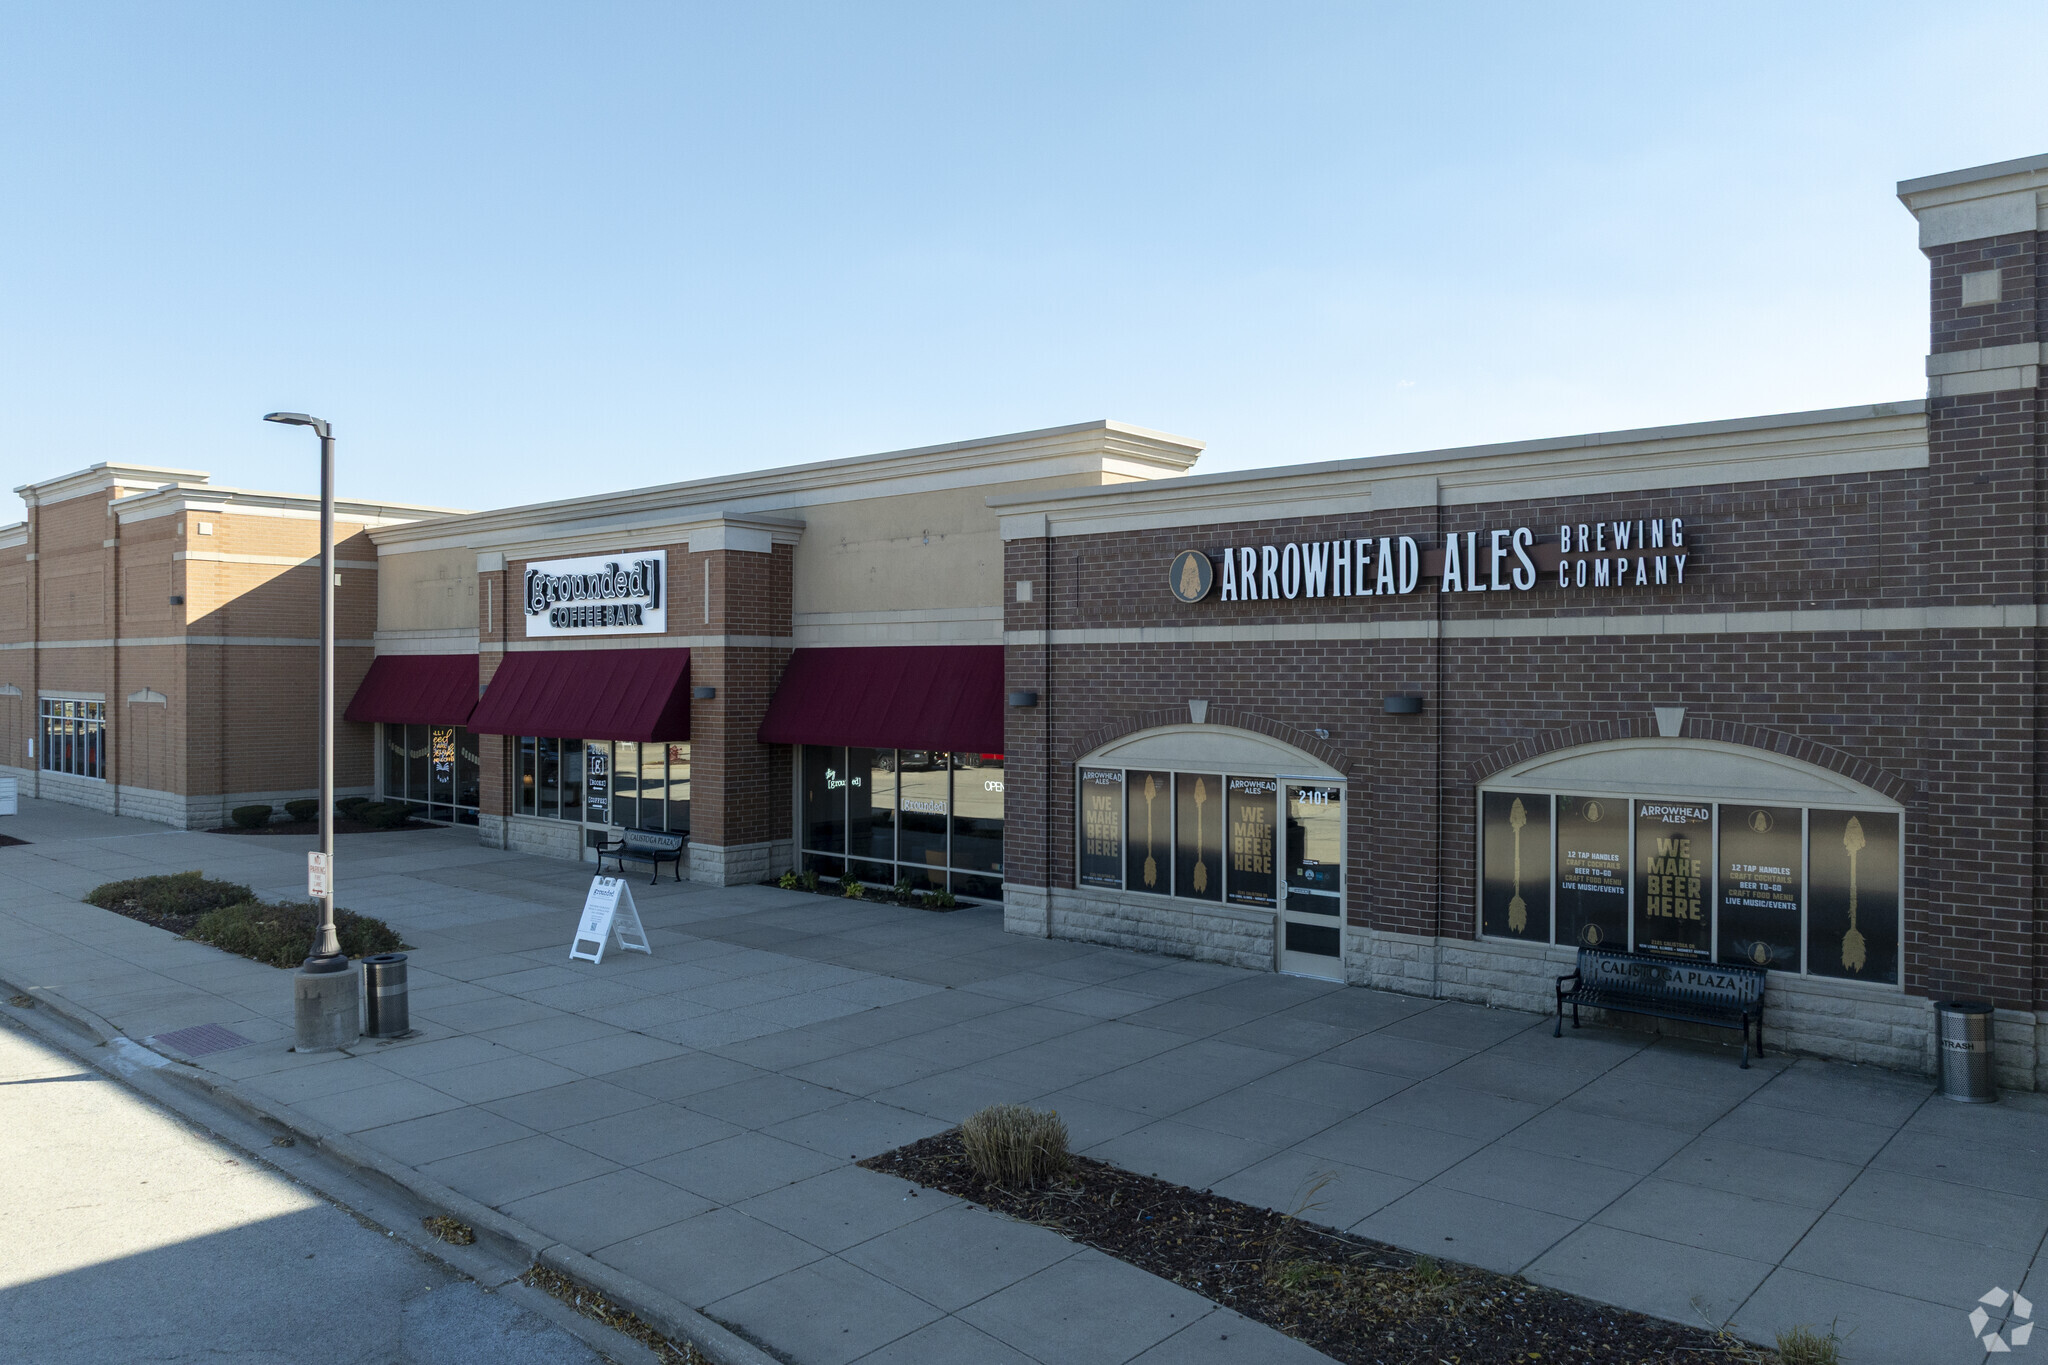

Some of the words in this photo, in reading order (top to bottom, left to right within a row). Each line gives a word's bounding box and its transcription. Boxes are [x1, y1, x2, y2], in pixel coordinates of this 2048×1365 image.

[1560, 517, 1684, 553] BREWING
[1220, 535, 1420, 602] ARROWHEAD
[1441, 527, 1537, 592] ALES
[1559, 554, 1687, 588] COMPANY
[549, 605, 604, 628] COFFEE
[605, 604, 643, 626] BAR
[1083, 772, 1122, 782] ARROWHEAD
[1230, 780, 1276, 792] ARROWHEAD
[1092, 796, 1112, 811] WE
[1298, 790, 1328, 805] 2101
[1241, 806, 1264, 822] WE
[1640, 805, 1709, 820] ARROWHEAD
[1662, 815, 1686, 824] ALES
[630, 833, 657, 845] CALISTOGA
[658, 837, 673, 846] PLAZA
[1087, 824, 1118, 840] BEER
[1087, 840, 1118, 857] HERE
[1234, 837, 1272, 856] BEER
[1656, 838, 1690, 858] WE
[1234, 854, 1272, 874] HERE
[1566, 858, 1585, 866] CRAFT
[1592, 853, 1619, 862] HANDLES
[1592, 869, 1612, 877] TO-GO
[1758, 866, 1790, 875] HANDLES
[1586, 876, 1602, 884] FOOD
[1648, 875, 1700, 898] BEER
[1740, 882, 1756, 890] BEER
[1759, 883, 1782, 892] TO-GO
[1578, 884, 1624, 894] MUSIC/EVENTS
[1728, 889, 1750, 897] CRAFT
[1752, 890, 1770, 899] FOOD
[1773, 893, 1794, 901] MENU
[1648, 896, 1700, 920] HERE
[1726, 897, 1741, 905] LIVE
[1742, 899, 1797, 910] MUSIC/EVENTS
[1601, 960, 1683, 983] CALISTOGA
[1688, 971, 1736, 990] PLAZA
[1944, 1040, 1974, 1050] TRASH
